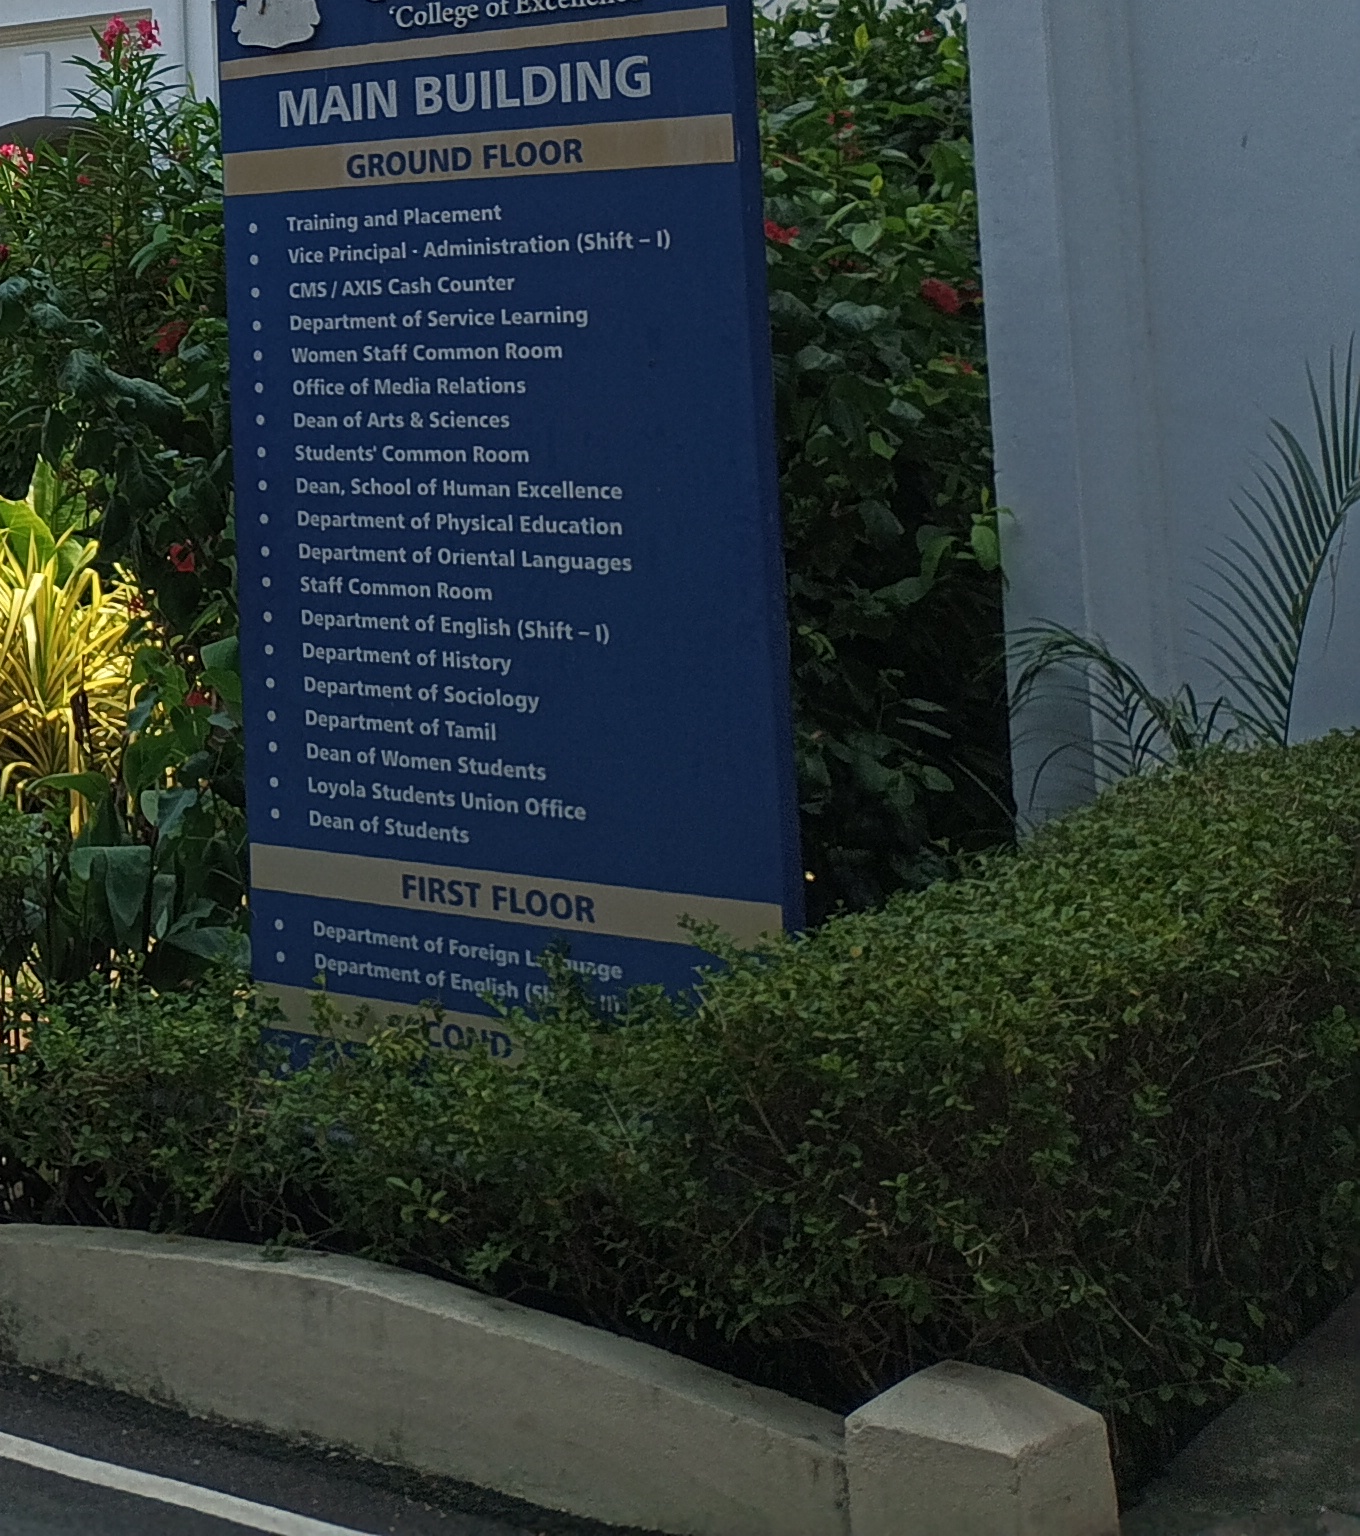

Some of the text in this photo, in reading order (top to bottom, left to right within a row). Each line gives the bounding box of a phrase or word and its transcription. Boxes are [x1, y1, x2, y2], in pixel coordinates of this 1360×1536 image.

[278, 54, 650, 127] MAIN BUILDING
[346, 138, 583, 178] GROUND FLOOR
[286, 204, 501, 232] Training and Placement
[287, 246, 323, 263] Vice
[328, 241, 406, 263] Principal
[423, 234, 569, 257] Administration
[576, 230, 634, 253] (Shift
[656, 228, 670, 249] I)
[289, 275, 515, 298] CMS / AXIS Cash Counter
[289, 305, 588, 334] Department of Service Learning
[291, 342, 562, 362] Women Staff Common Room
[292, 376, 526, 395] Office of Media Relations
[293, 410, 509, 428] Dean of Arts & Sciences
[381, 445, 466, 462] Common
[472, 445, 529, 462] Room
[296, 477, 622, 499] Dean, School of Human Excellence
[297, 510, 622, 535] Department of Physical Education
[298, 542, 632, 575] Department of Oriental Languages
[300, 575, 492, 600] Staff Common Room
[301, 609, 409, 630] Department
[414, 614, 435, 632] of
[440, 616, 510, 639] English
[517, 619, 573, 640] (Shift
[595, 623, 609, 644] I)
[302, 642, 511, 676] Department of History
[303, 676, 539, 713] Department of Sociology
[305, 709, 496, 741] Department of Tamil
[306, 742, 546, 780] Dean of Women Students
[307, 776, 586, 820] Loyola Students Union Office
[309, 809, 469, 843] Dean of Students
[401, 873, 595, 923] FIRST FLOOR
[313, 920, 622, 982] Department of Foreign Luage
[315, 953, 420, 982] Department
[425, 969, 446, 987] of
[451, 973, 518, 999] English
